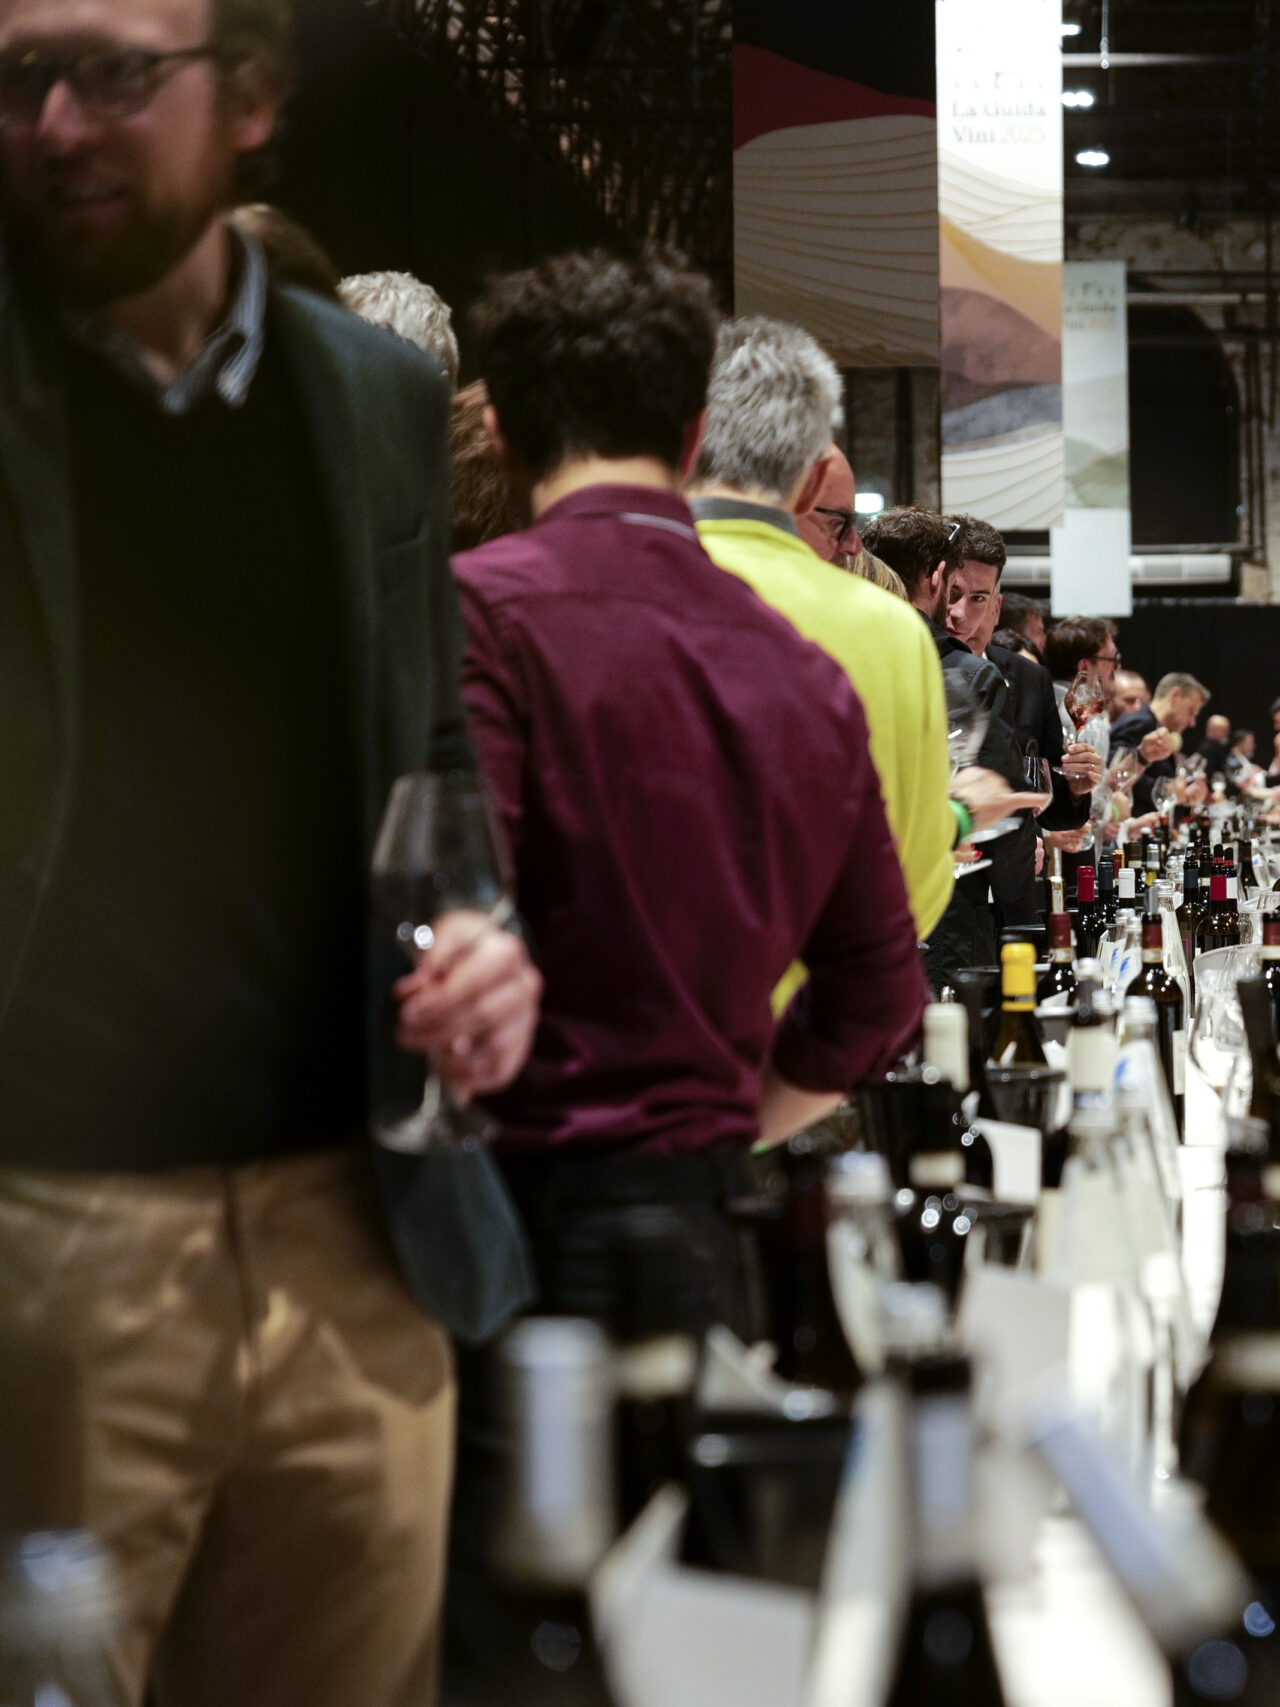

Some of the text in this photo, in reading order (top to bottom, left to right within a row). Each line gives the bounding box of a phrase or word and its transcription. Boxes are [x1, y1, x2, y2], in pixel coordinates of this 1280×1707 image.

[952, 100, 1046, 117] La Guida
[952, 123, 1046, 143] Vini 2025
